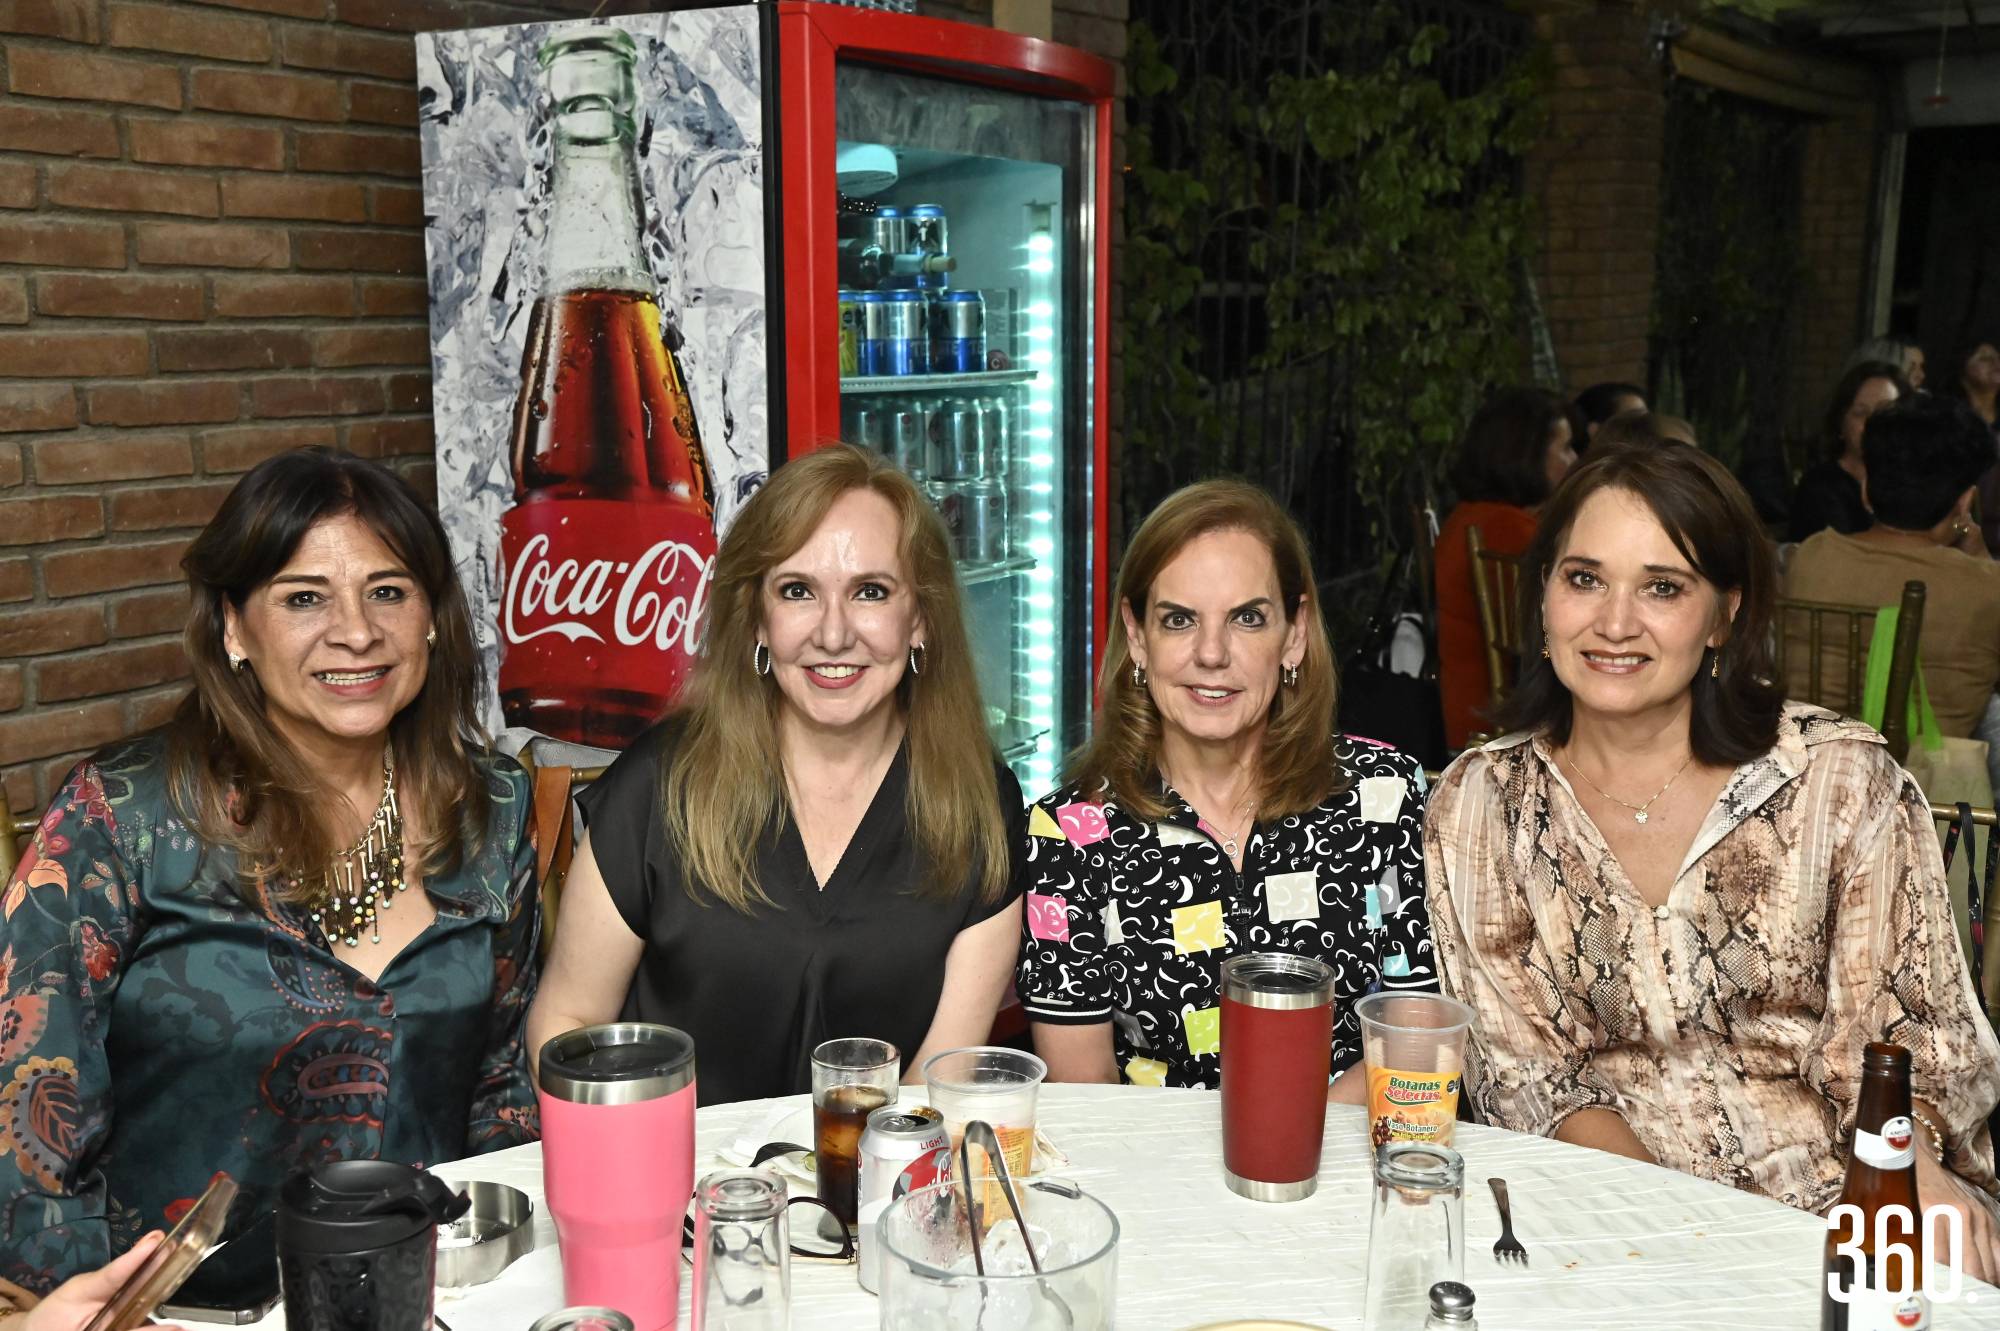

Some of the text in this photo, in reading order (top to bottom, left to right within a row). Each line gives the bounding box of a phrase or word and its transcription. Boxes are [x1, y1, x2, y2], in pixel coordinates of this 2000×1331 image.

[505, 533, 715, 656] Coca-Col
[1390, 1077, 1441, 1091] Botanas
[1387, 1087, 1441, 1101] Selectas
[1387, 1117, 1438, 1133] Vaso Botanero
[920, 1136, 944, 1150] LIGHT
